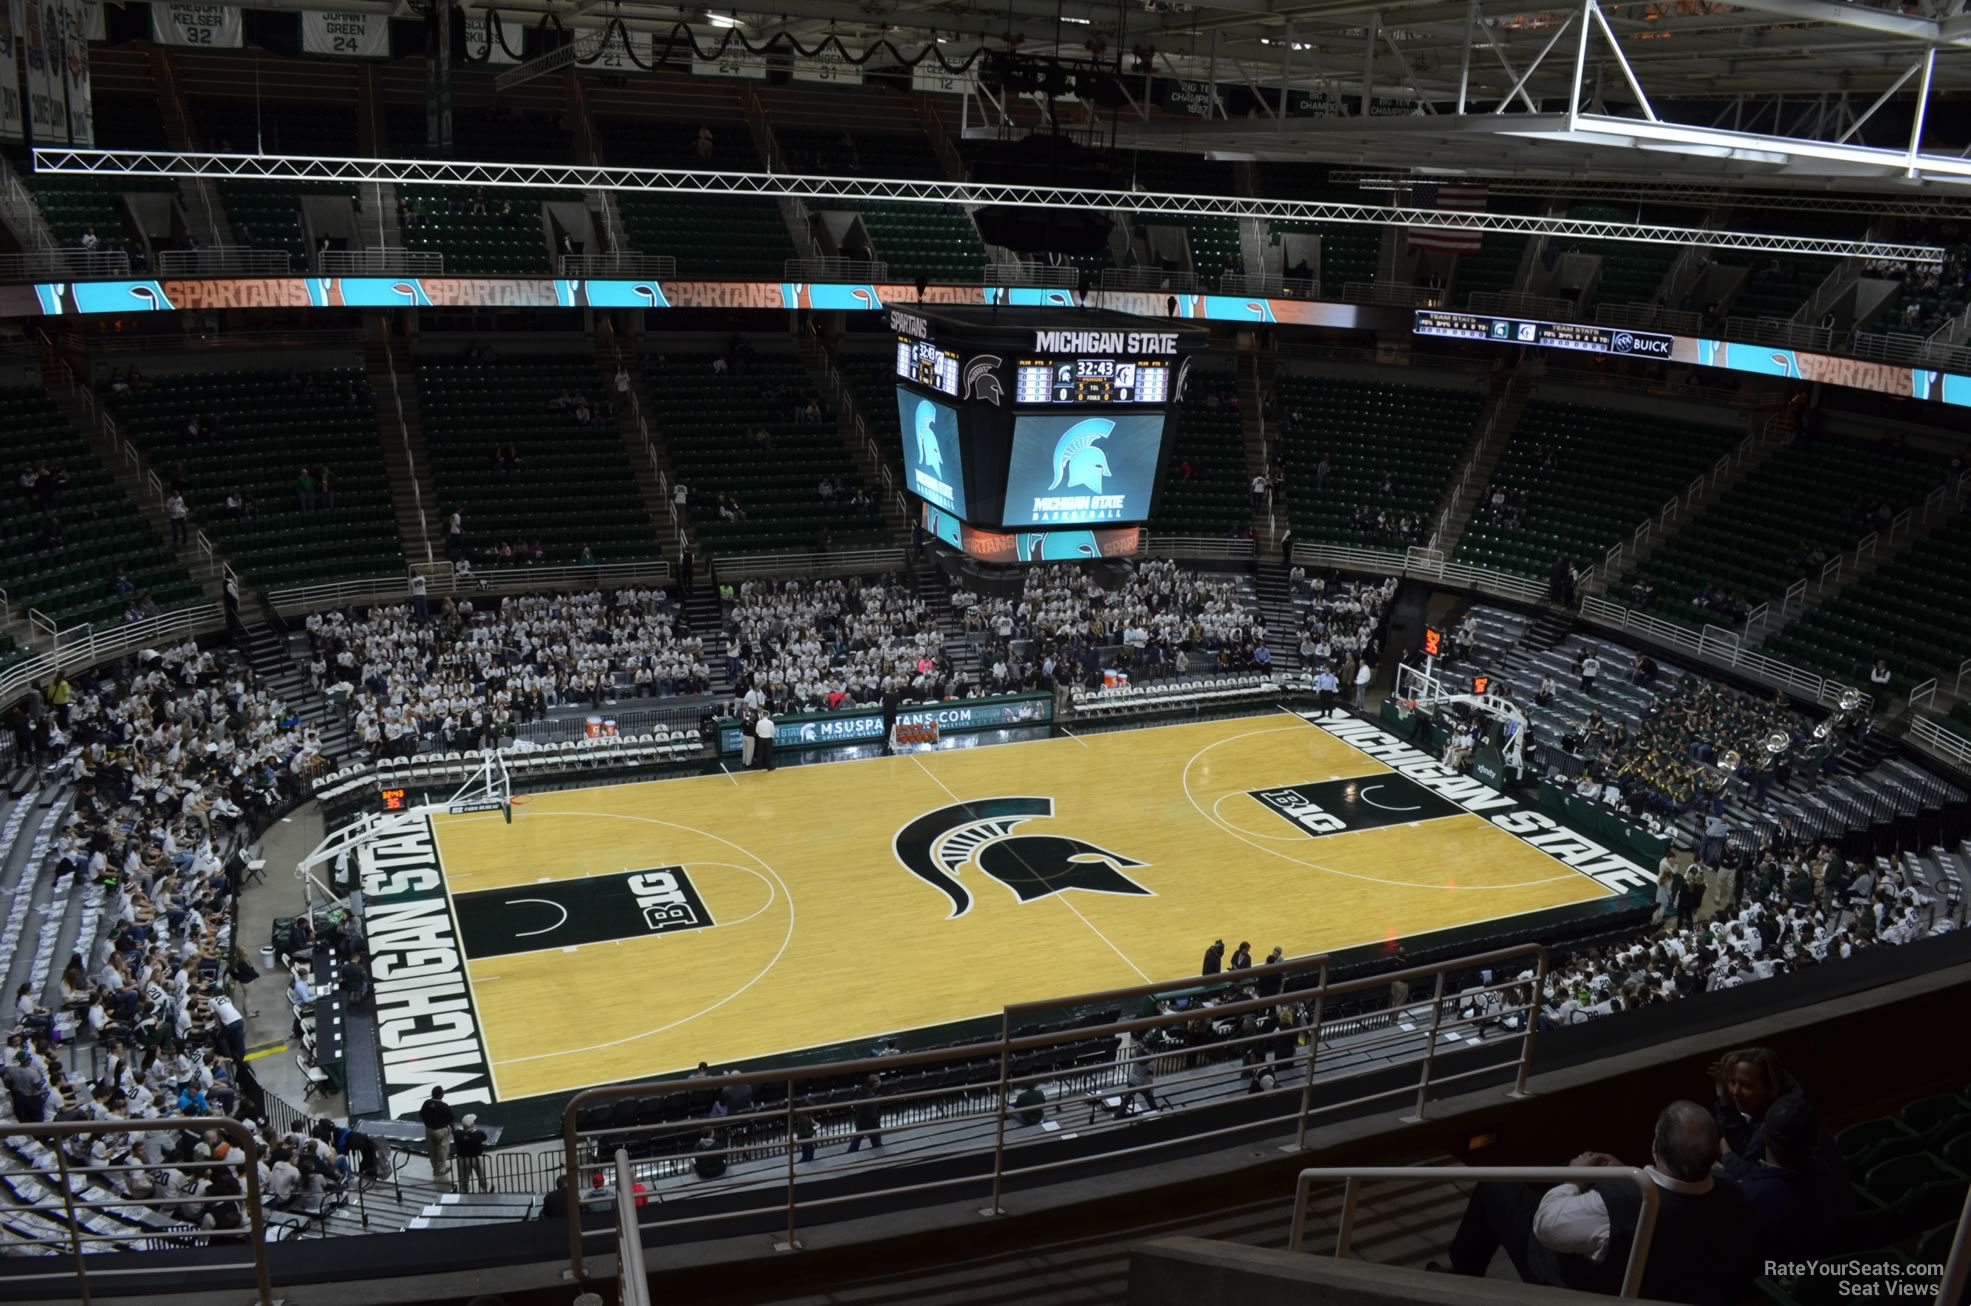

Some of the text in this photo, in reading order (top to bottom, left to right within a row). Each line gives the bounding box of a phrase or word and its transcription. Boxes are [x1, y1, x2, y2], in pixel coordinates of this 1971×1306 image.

[173, 13, 222, 27] KELSER
[187, 27, 211, 44] 32
[326, 23, 365, 36] GREEN
[333, 37, 358, 52] 24
[938, 77, 953, 90] 12
[164, 280, 308, 309] SPARTANS
[425, 279, 557, 306] SPARTANS
[663, 282, 781, 309] SPARTANS
[1430, 313, 1451, 321] TEAM
[890, 311, 927, 339] SPARTANS
[1553, 325, 1574, 333] TEAM
[1035, 331, 1180, 355] MICHIGAN STATE
[1633, 338, 1669, 353] BUICK
[1077, 362, 1113, 376] 32:43
[1799, 352, 1913, 397] SPARTANS
[1078, 383, 1084, 391] 5
[1105, 383, 1110, 391] 5
[1120, 388, 1127, 400] 0
[1060, 388, 1067, 401] 0
[1032, 494, 1126, 512] MICHIGAN STATE
[1032, 509, 1122, 521] BASKETBALL
[382, 789, 405, 800] 32:43
[1300, 707, 1659, 895] MICHIGAN STATE
[387, 798, 401, 809] 35
[1741, 943, 1752, 953] 20
[148, 986, 161, 1001] 20
[1487, 993, 1498, 1004] 20
[364, 898, 492, 1120] MICHIGAN
[127, 1086, 139, 1100] 20
[154, 1169, 169, 1186] 20
[181, 1181, 198, 1195] 20
